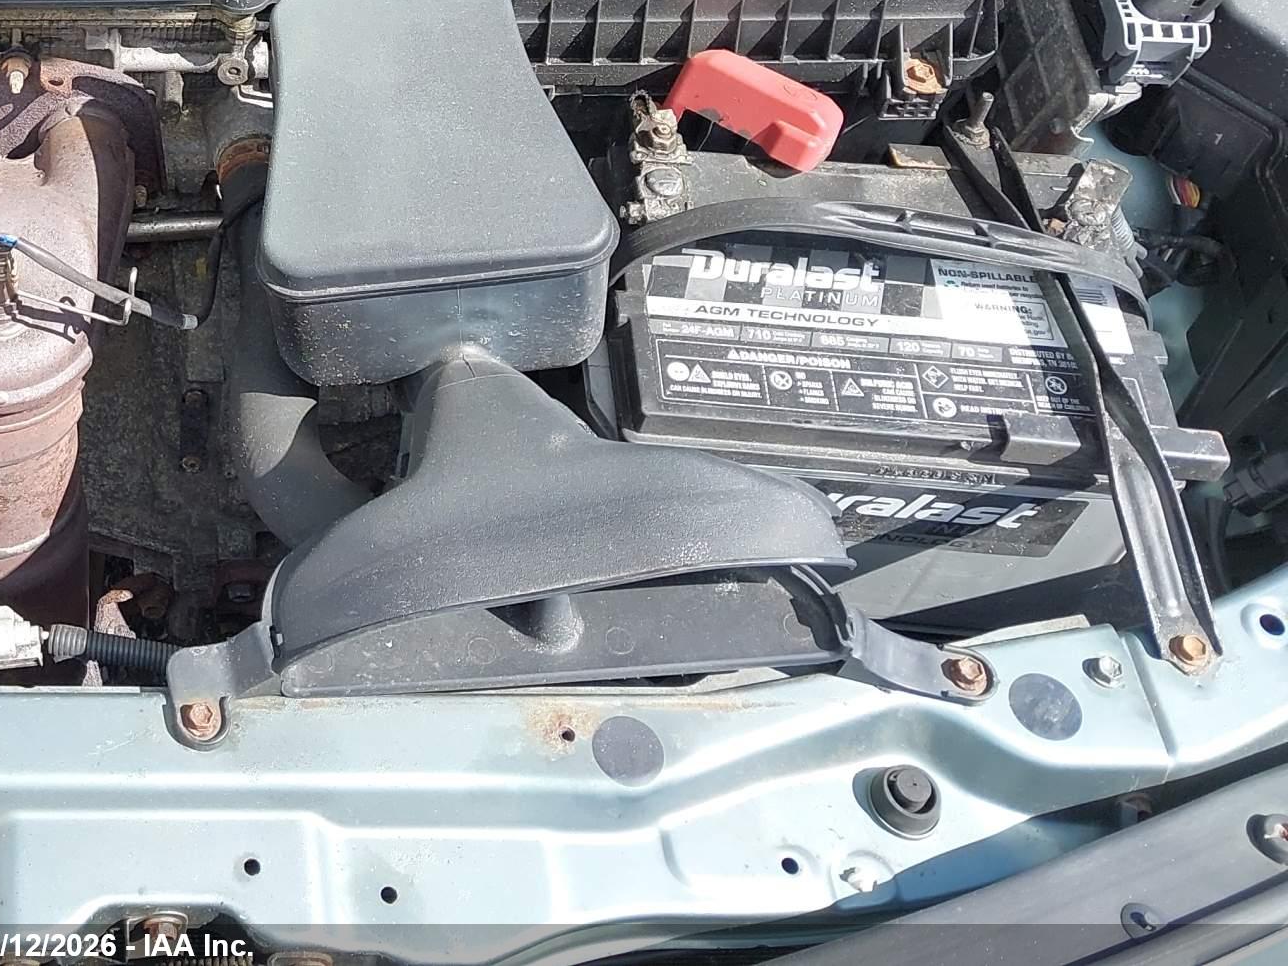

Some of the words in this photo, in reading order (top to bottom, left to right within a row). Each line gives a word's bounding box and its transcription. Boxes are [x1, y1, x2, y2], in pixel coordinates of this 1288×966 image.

[682, 248, 882, 293] Duralast
[938, 267, 1037, 284] NON-SPILLABLE
[760, 287, 880, 307] PLATINUM
[695, 305, 740, 317] AGM
[746, 308, 880, 327] TECHNOLOGY
[897, 341, 920, 353] 120
[958, 346, 976, 358] 70
[739, 350, 851, 370] DANGER/POISON
